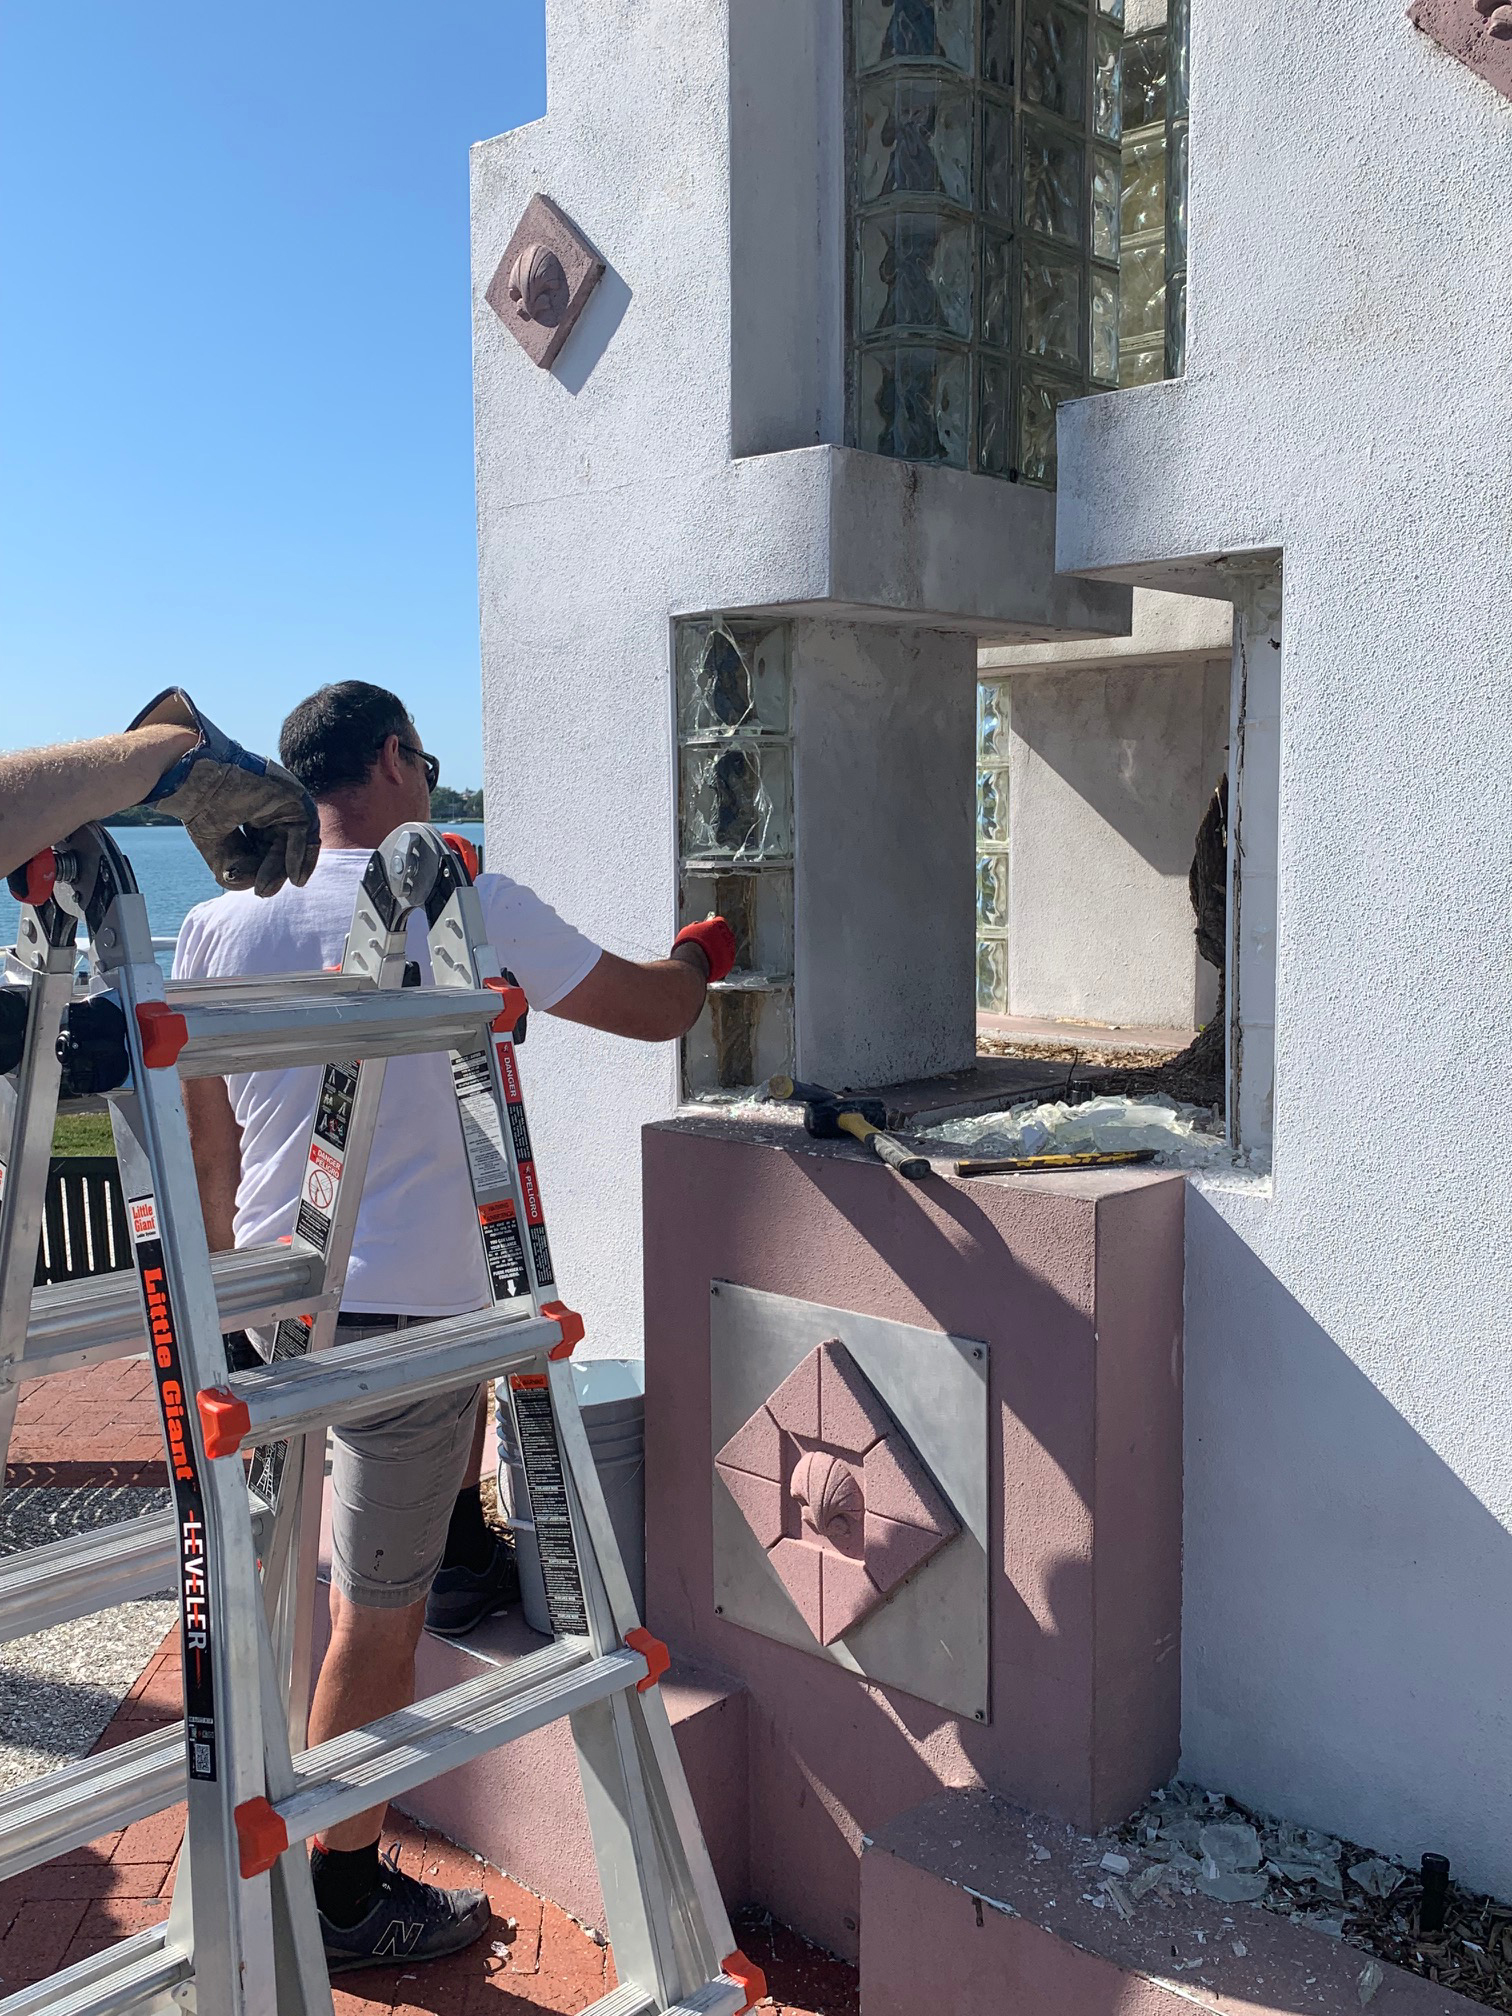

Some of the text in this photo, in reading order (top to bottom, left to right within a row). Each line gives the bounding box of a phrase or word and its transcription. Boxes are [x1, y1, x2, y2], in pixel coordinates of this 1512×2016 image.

[504, 1057, 517, 1098] DANGER
[315, 1157, 340, 1179] PELIGRO
[317, 1149, 341, 1170] DANGER
[132, 1204, 153, 1219] Little
[525, 1175, 538, 1218] PELIGRO
[134, 1216, 156, 1232] Giant
[144, 1267, 194, 1481] Little Giant
[183, 1521, 207, 1650] LEVELER
[372, 1920, 424, 1957] N
